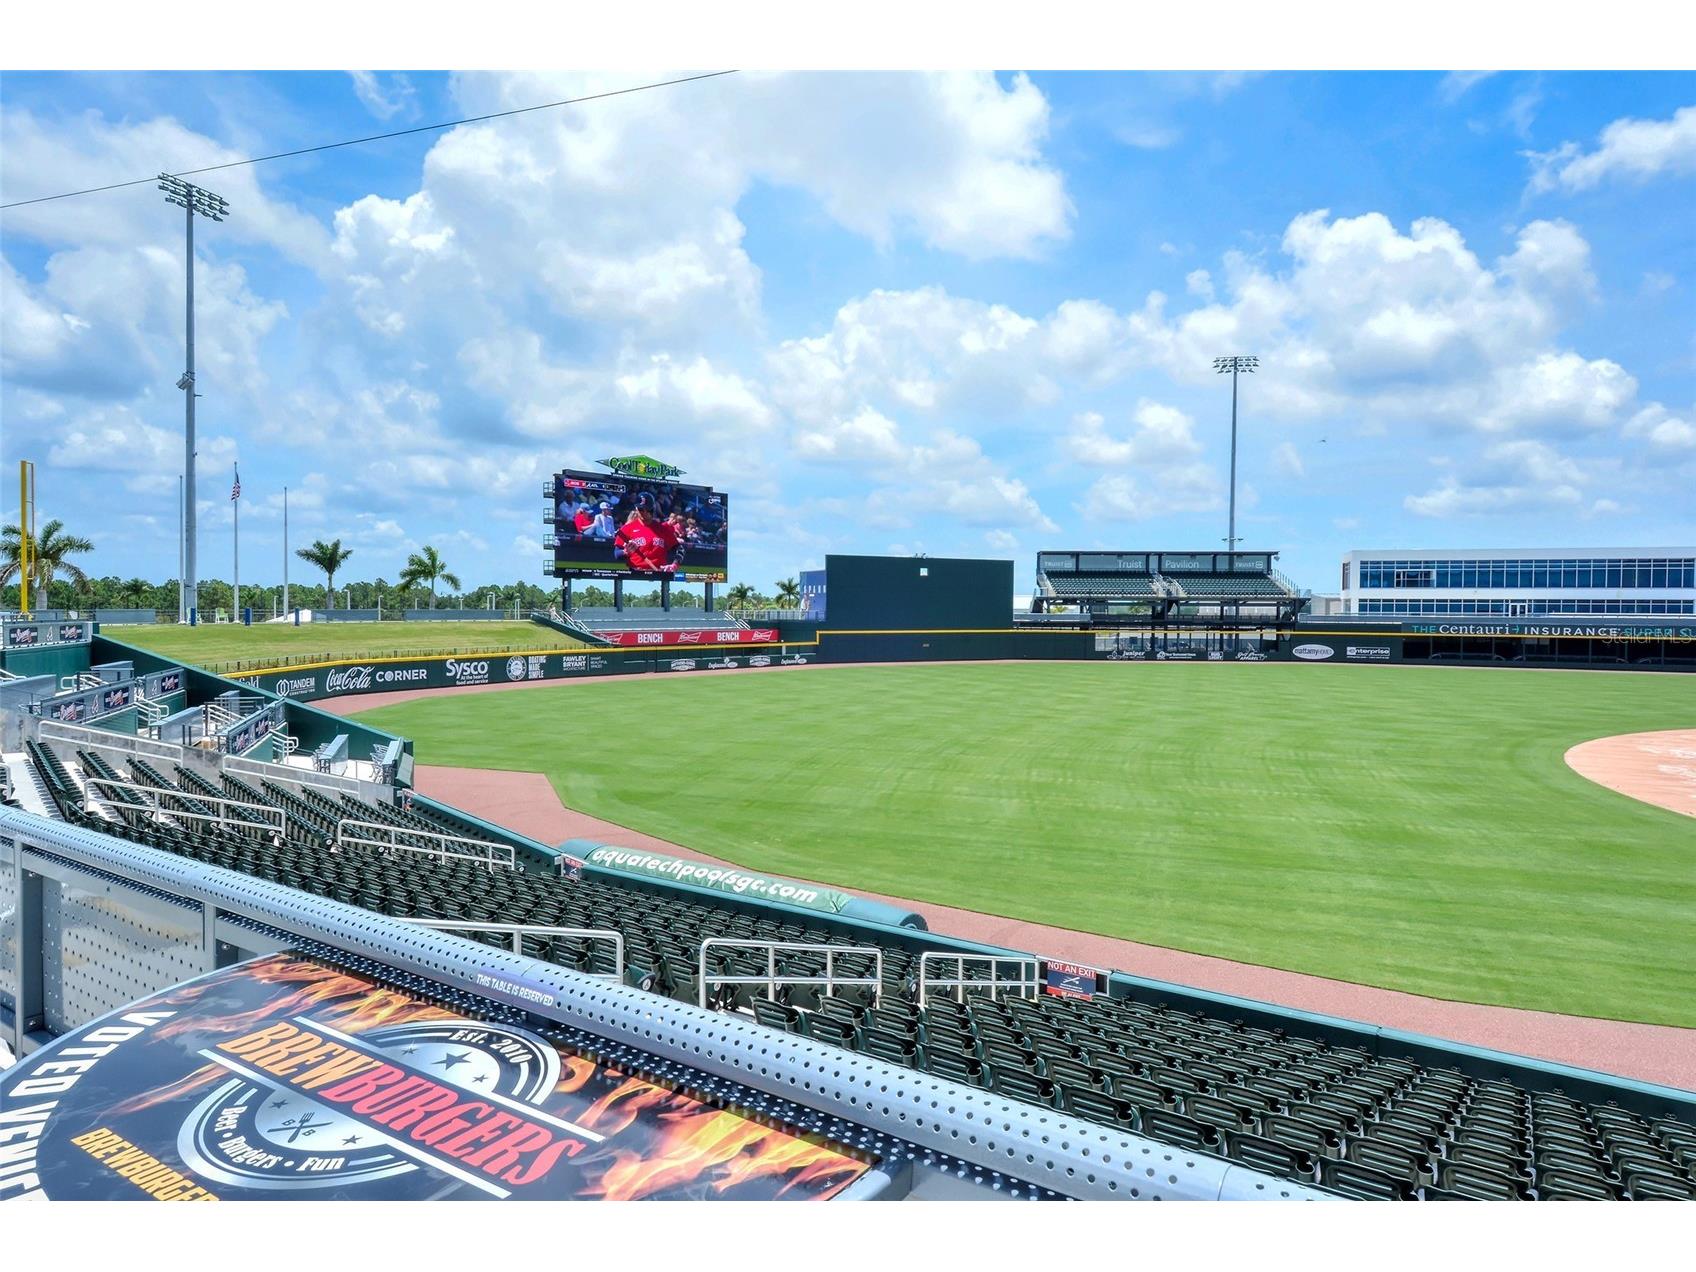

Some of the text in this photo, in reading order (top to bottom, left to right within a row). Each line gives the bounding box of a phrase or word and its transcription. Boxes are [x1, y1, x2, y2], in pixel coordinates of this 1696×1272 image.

[1117, 560, 1199, 569] Truist Pavilion
[717, 632, 740, 641] BENCH
[1411, 625, 1437, 634] THE
[1439, 624, 1510, 635] Centauri
[1524, 626, 1618, 636] INSURANCE
[637, 633, 663, 644] BENCH
[375, 669, 427, 682] CORNER
[445, 658, 489, 679] Sysco
[289, 677, 315, 690] TANDEM
[1047, 961, 1096, 978] NOT AN EXIT
[476, 973, 553, 1006] THIS TABLE IS RESERVED
[9, 1011, 178, 1097] VOTED
[489, 1038, 533, 1064] 2010
[214, 1105, 346, 1172] Beer Burgers Fun
